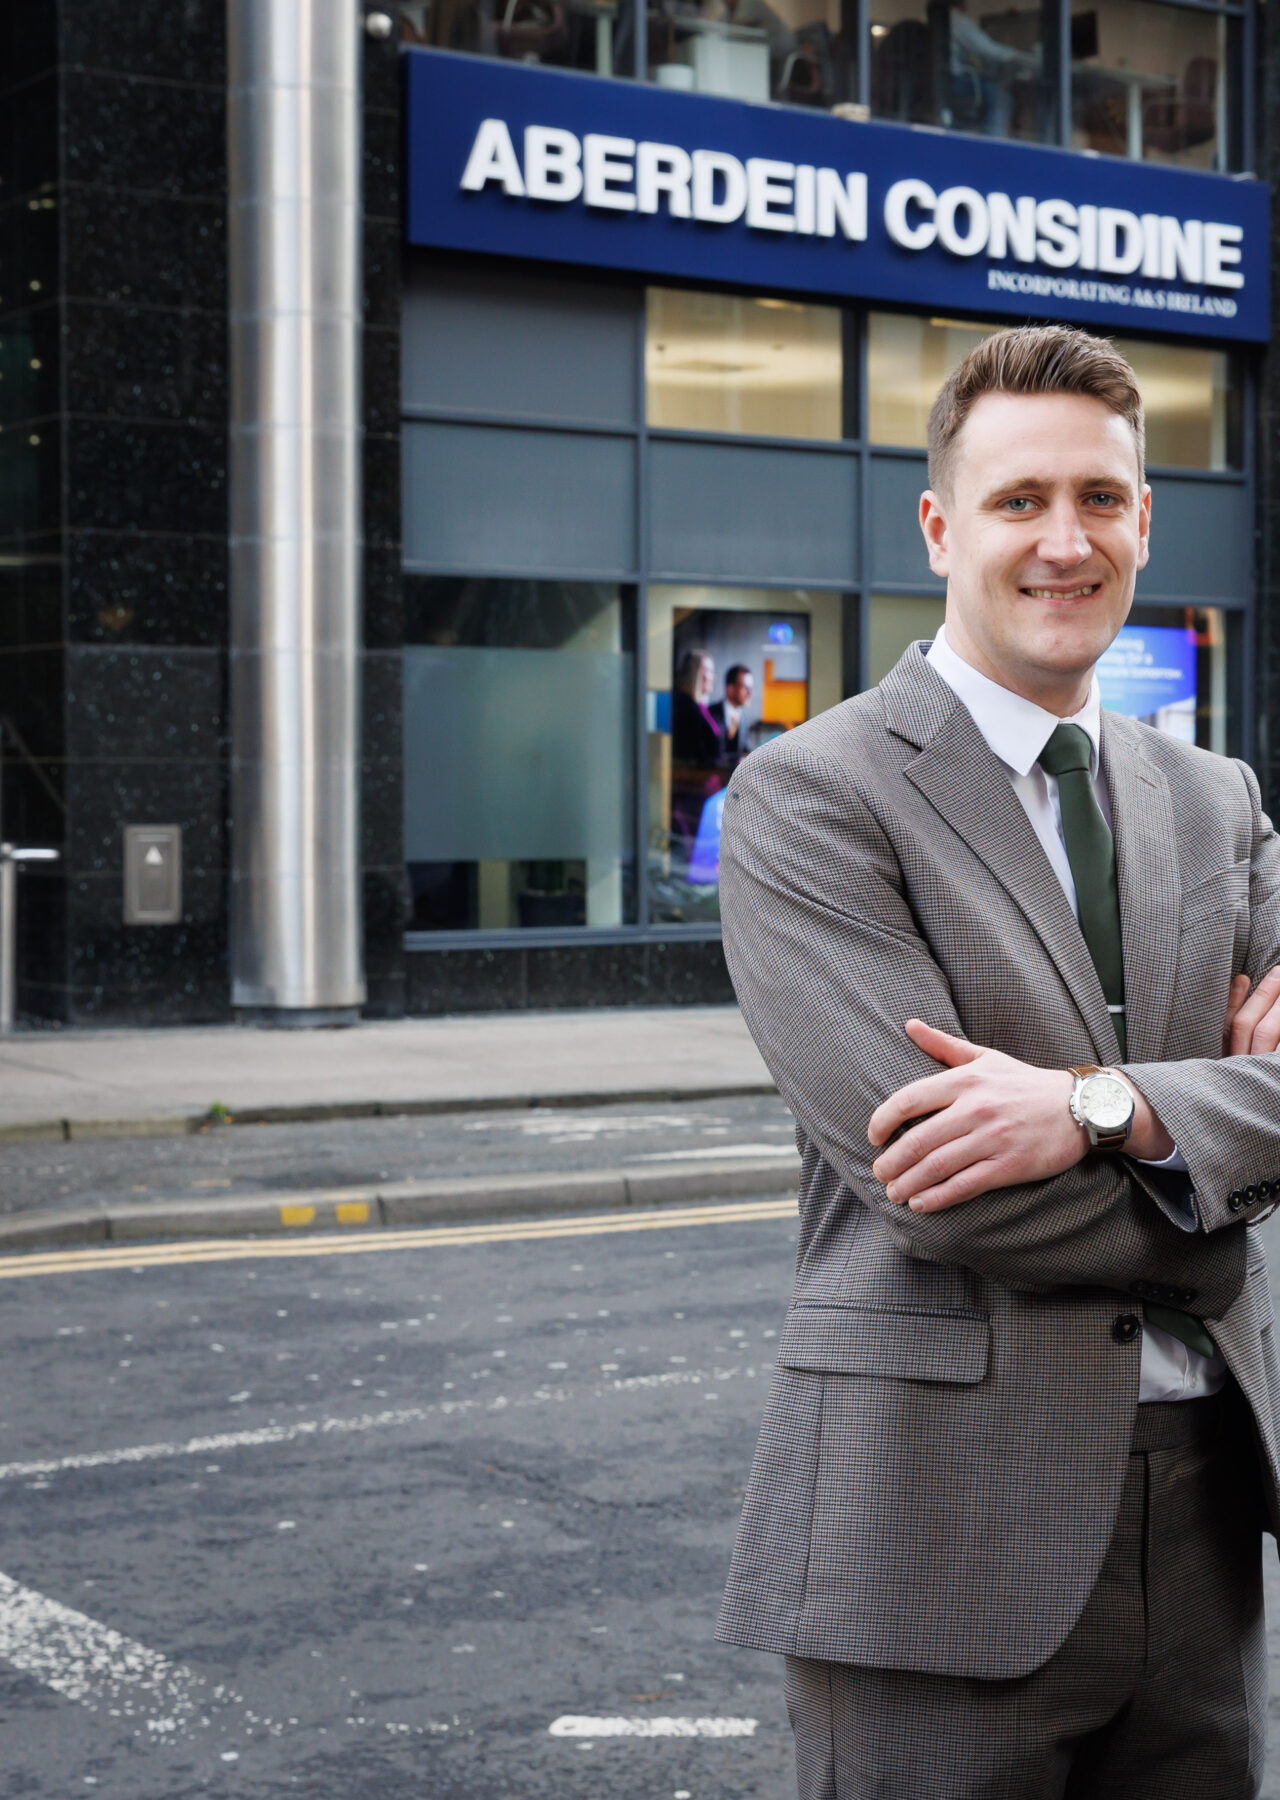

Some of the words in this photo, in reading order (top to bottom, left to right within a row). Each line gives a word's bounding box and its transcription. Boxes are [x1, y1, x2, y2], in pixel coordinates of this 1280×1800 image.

[460, 118, 868, 242] ABERDEIN
[884, 178, 1244, 290] CONSIDINE
[987, 269, 1131, 305] INCORPORATING
[1166, 290, 1238, 319] IRELAND
